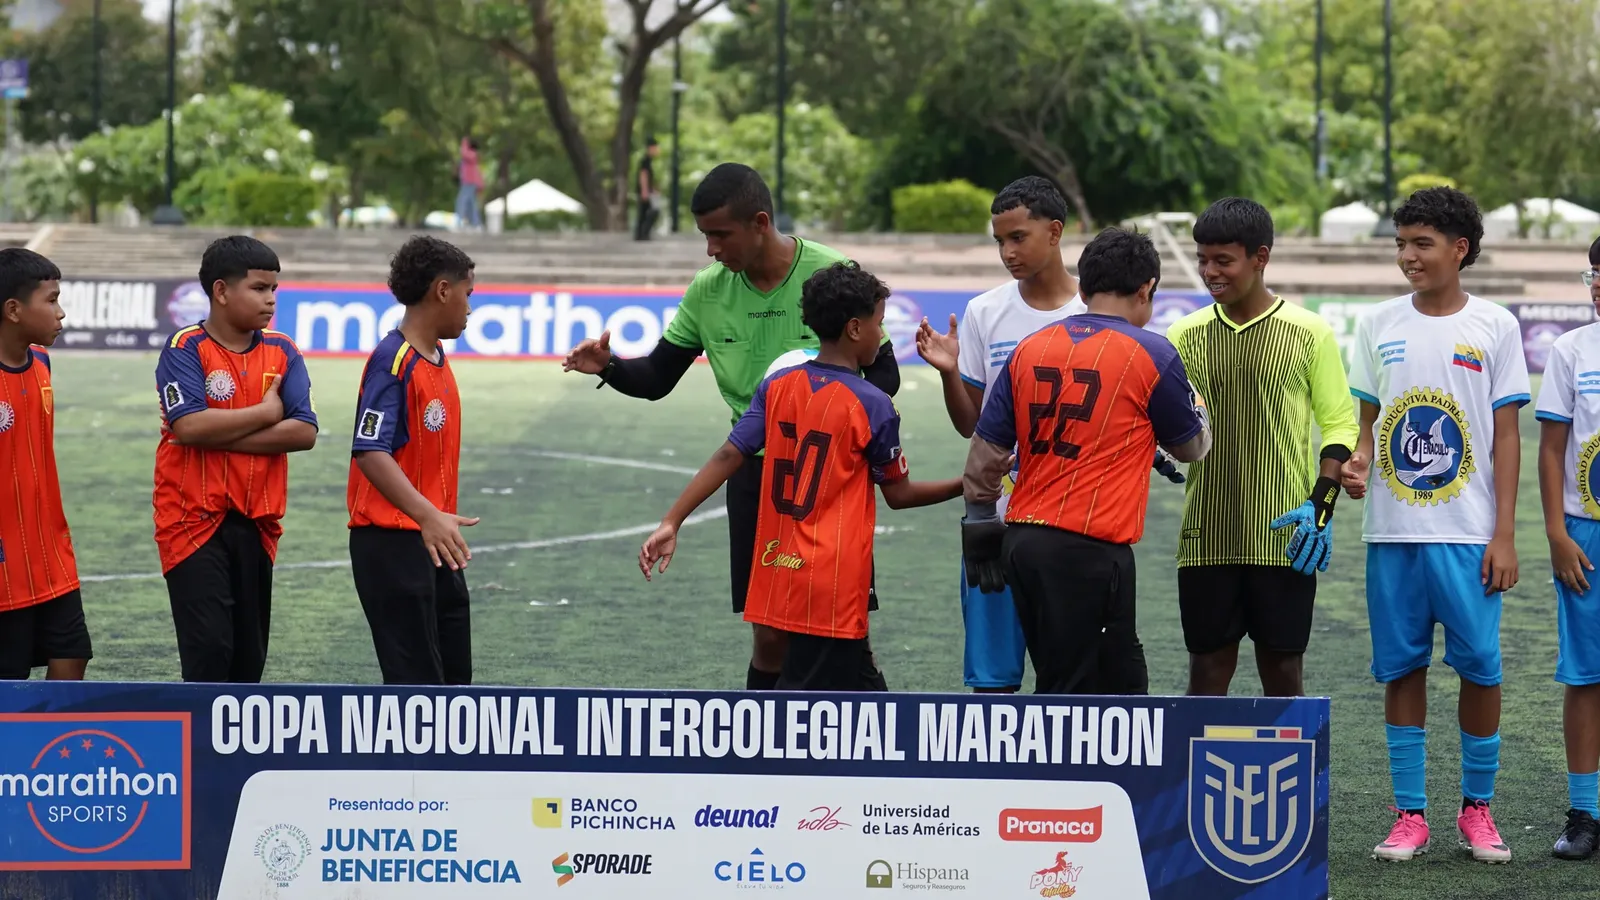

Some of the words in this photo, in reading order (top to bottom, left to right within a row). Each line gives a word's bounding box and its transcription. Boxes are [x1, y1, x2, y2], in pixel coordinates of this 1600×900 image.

[747, 309, 787, 319] marathon
[1029, 366, 1102, 460] 22
[1385, 394, 1428, 432] EDUCATIVA
[1380, 434, 1392, 476] UNIDAD
[1584, 437, 1600, 460] EDU
[1580, 460, 1590, 502] UNIDAD
[1414, 491, 1433, 500] 1989
[211, 695, 328, 754] COPA
[341, 695, 564, 755] NACIONAL
[576, 697, 905, 761] INTERCOLEGIAL
[918, 702, 1164, 766] MARATHON
[0, 766, 177, 796] marathon
[48, 805, 127, 822] SPORTS
[328, 798, 414, 811] Presentado
[418, 800, 449, 813] por:
[571, 798, 637, 812] BANCO
[694, 804, 779, 828] deuna!
[863, 804, 950, 818] Universidad
[571, 816, 676, 830] PICHINCHA
[862, 822, 880, 835] de
[885, 823, 908, 835] Las
[912, 823, 980, 836] Américas
[1006, 816, 1094, 835] Pronaca
[320, 828, 416, 852] JUNTA
[422, 829, 458, 852] DE
[322, 859, 521, 883] BENEFICENCIA
[572, 853, 652, 875] SPORADE
[897, 862, 969, 883] Hispana
[902, 883, 926, 891] Seguros
[932, 883, 966, 891] Reaseguros
[1030, 865, 1083, 890] PONY
